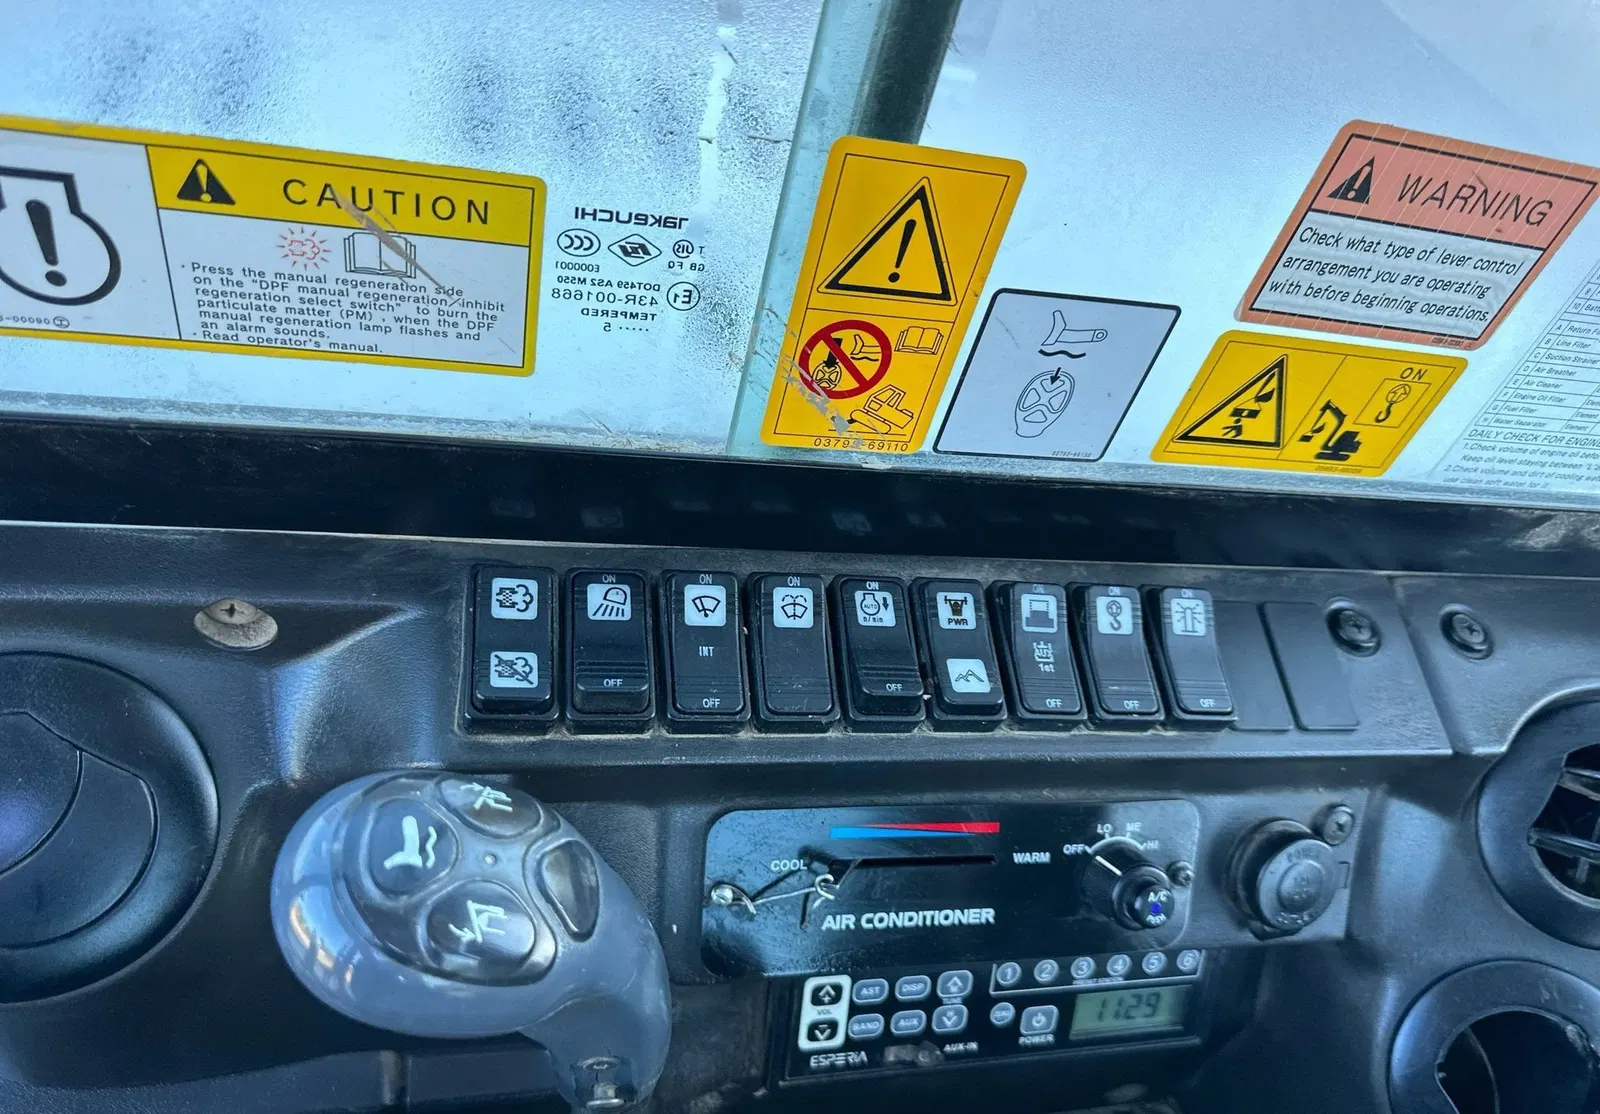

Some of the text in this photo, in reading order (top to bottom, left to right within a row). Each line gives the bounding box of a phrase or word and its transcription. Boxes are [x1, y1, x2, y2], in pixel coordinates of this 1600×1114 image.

[282, 178, 489, 226] CAUTION
[1398, 173, 1553, 227] WARNING
[1299, 226, 1524, 276] Check what type of lever control
[191, 262, 464, 297] Press the manual regeneration side
[1282, 254, 1492, 300] arrangement you are operating
[193, 276, 212, 285] on
[220, 277, 244, 288] the
[298, 286, 349, 298] manual
[195, 287, 291, 303] regeneration
[299, 297, 343, 308] select
[416, 306, 430, 316] to
[438, 307, 469, 319] burn
[476, 311, 498, 322] the
[1268, 280, 1490, 324] with before beginning operations.
[197, 299, 277, 313] particulate
[285, 306, 331, 317] matter
[394, 315, 430, 326] when
[438, 318, 459, 329] the
[467, 321, 495, 332] DPF
[200, 311, 481, 341] manual regeneration lamp flashes and
[201, 321, 330, 339] an alarm sounds.
[1567, 325, 1592, 334] Return
[203, 330, 383, 353] Read operator's manual.
[1556, 339, 1571, 347] Line
[1572, 341, 1592, 349] Filter
[1545, 353, 1572, 362] Suction
[1572, 356, 1600, 365] Strainer
[1399, 367, 1429, 381] ON
[1546, 367, 1577, 376] Breather
[1536, 381, 1563, 389] Cleaner
[1513, 393, 1536, 401] Engine
[1468, 429, 1503, 439] DAILY
[1503, 432, 1539, 442] CHECK
[1541, 436, 1566, 445] FOR
[813, 437, 909, 452] 0379-69110
[602, 574, 616, 583] ON
[699, 574, 713, 584] ON
[787, 576, 801, 587] ON
[866, 581, 879, 590] ON
[1108, 586, 1121, 596] ON
[1181, 588, 1194, 598] ON
[948, 618, 969, 626] PWR
[698, 646, 714, 657] INT
[1038, 663, 1055, 673] 1st
[603, 678, 623, 688] OFF
[885, 683, 903, 692] OFF
[702, 698, 721, 708] OFF
[1046, 698, 1063, 708] OFF
[1124, 700, 1140, 710] OFF
[1200, 698, 1216, 707] OFF
[1096, 823, 1113, 834] LO
[1063, 845, 1085, 855] OFF
[1147, 840, 1159, 849] HI
[1013, 852, 1051, 864] WARM
[770, 859, 808, 872] COOL
[1148, 889, 1168, 903] A/C
[821, 907, 996, 931] AIR CONDITIONER
[1040, 964, 1052, 978] 2
[1077, 961, 1089, 974] 3
[1112, 958, 1126, 972] 4
[1148, 956, 1160, 969] 5
[1183, 953, 1194, 966] 6
[860, 986, 880, 996] AST
[901, 983, 924, 992] DISP
[852, 1020, 880, 1031] BAND
[898, 1018, 919, 1028] AUX
[1018, 1034, 1055, 1046] POWER
[943, 1042, 979, 1053] AUX-IN
[809, 1051, 868, 1069] ESPERIA
